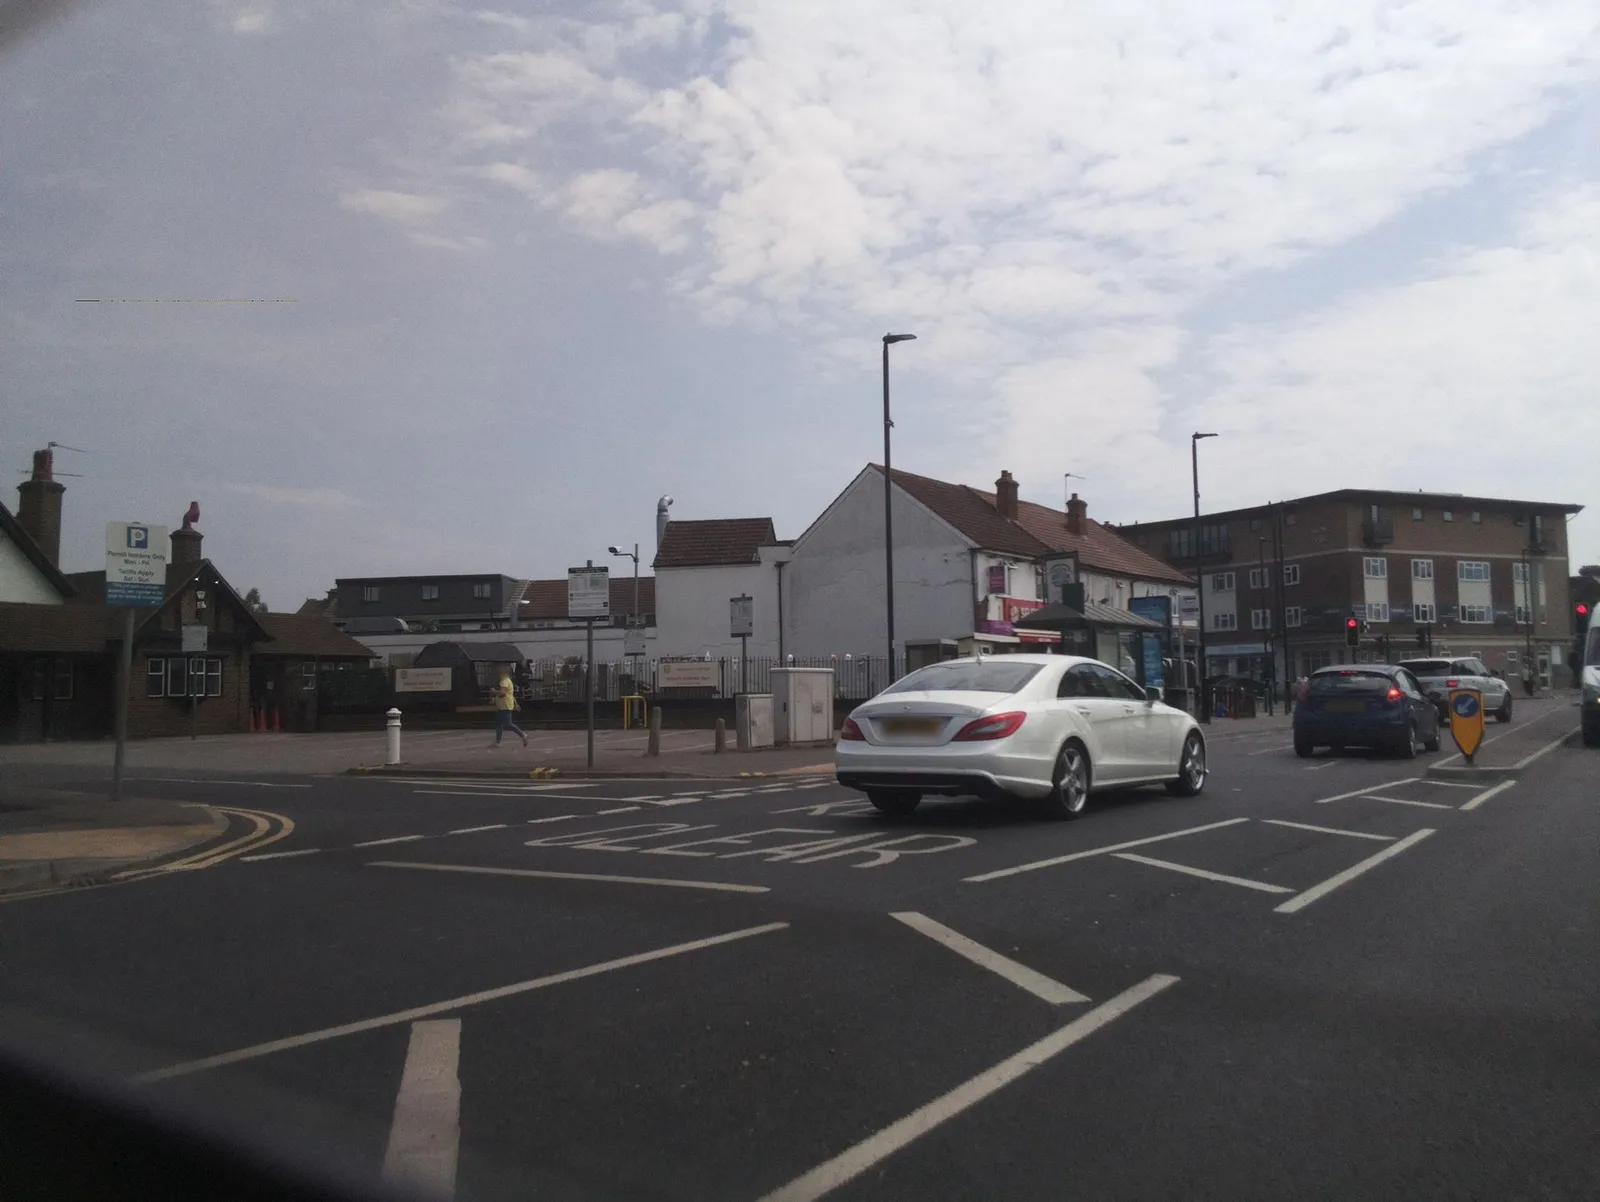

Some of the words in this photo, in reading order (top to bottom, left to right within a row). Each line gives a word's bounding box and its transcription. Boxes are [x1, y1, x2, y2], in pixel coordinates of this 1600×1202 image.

[130, 528, 145, 547] P
[128, 551, 151, 560] Holders
[152, 553, 166, 561] Only
[524, 822, 978, 869] CLEAR
